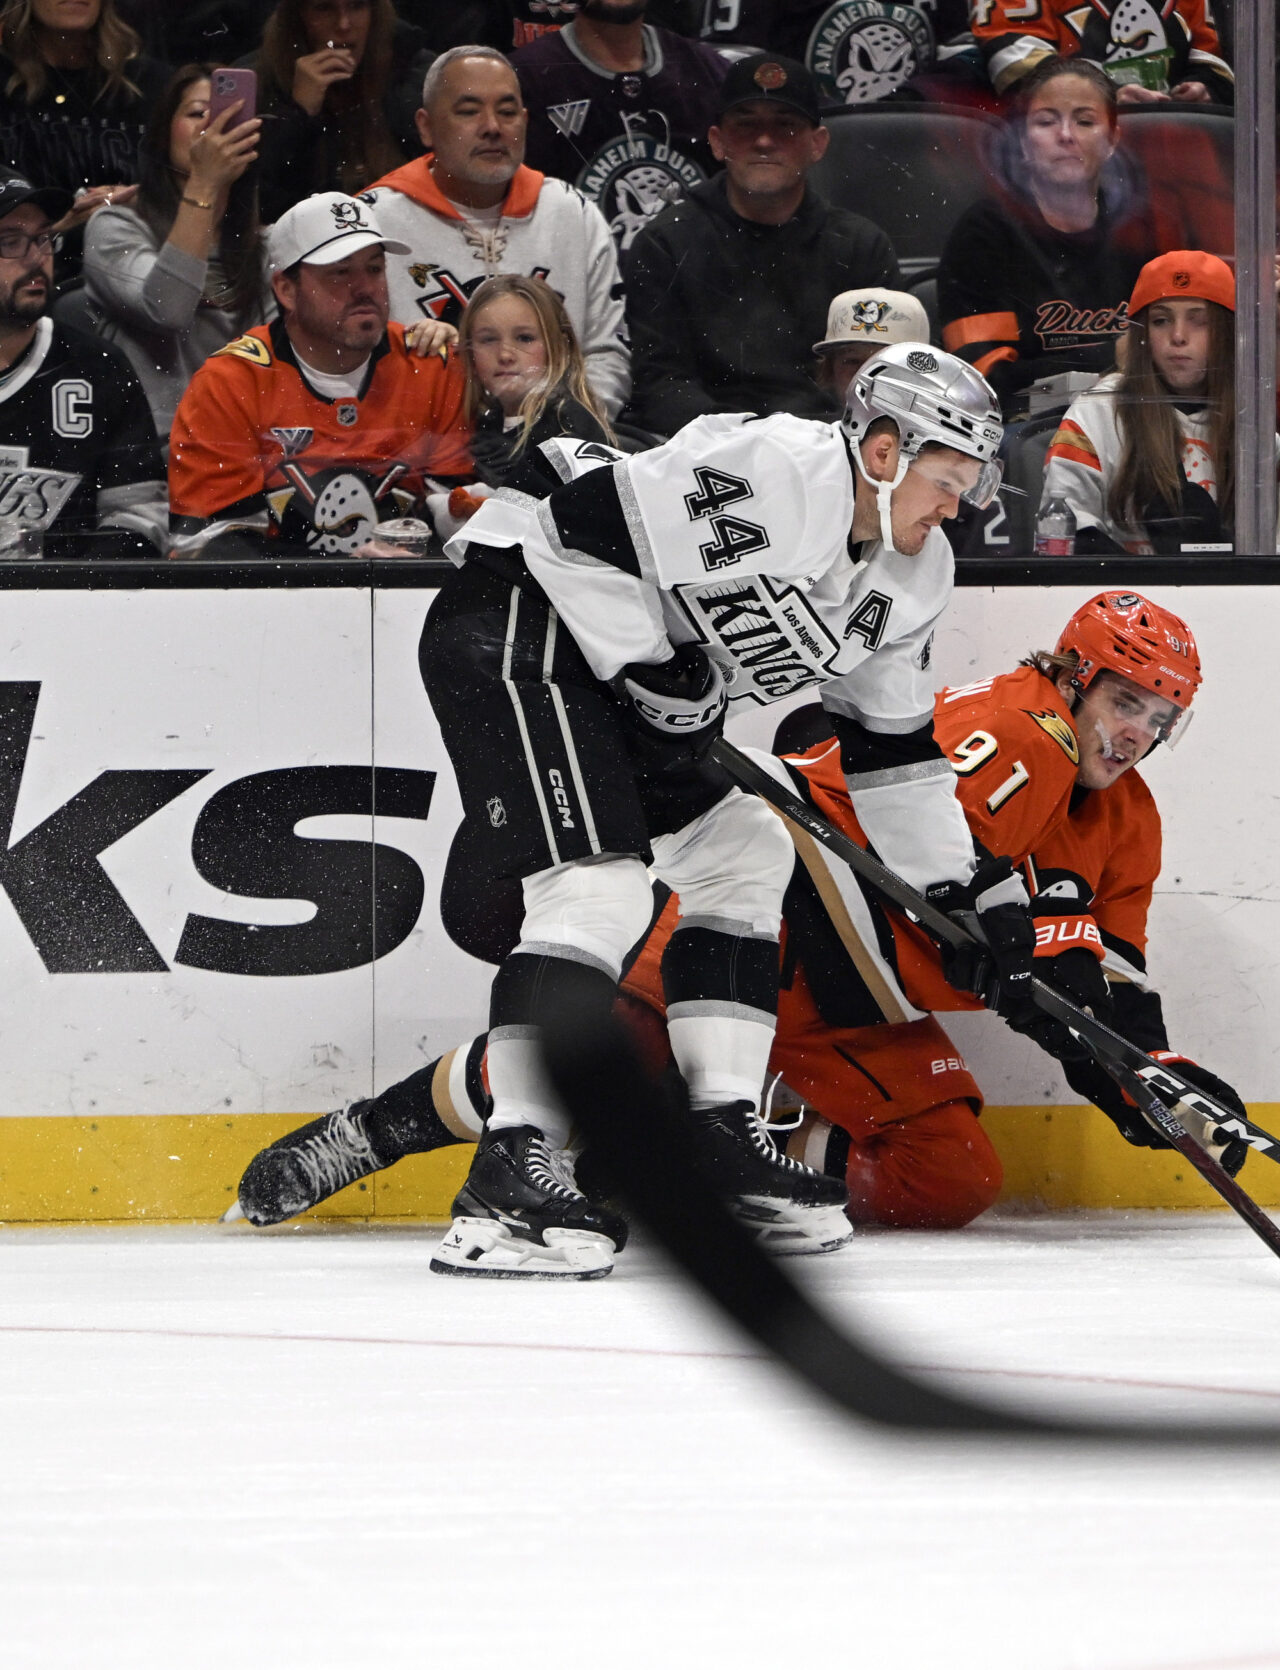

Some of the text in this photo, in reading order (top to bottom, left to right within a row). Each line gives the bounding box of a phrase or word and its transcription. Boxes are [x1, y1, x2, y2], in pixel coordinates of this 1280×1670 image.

[814, 2, 885, 75] ANAHEIM
[585, 140, 647, 196] AHEIM
[1033, 300, 1129, 335] Duck
[52, 379, 94, 439] C
[683, 465, 771, 572] 44
[696, 585, 828, 697] KINGS
[782, 606, 824, 659] Los Angeles
[843, 589, 894, 651] A
[1169, 636, 1189, 658] 91
[548, 768, 575, 829] CCM
[950, 730, 1030, 817] 91
[928, 885, 950, 898] CCM
[1138, 1066, 1274, 1151] CCM
